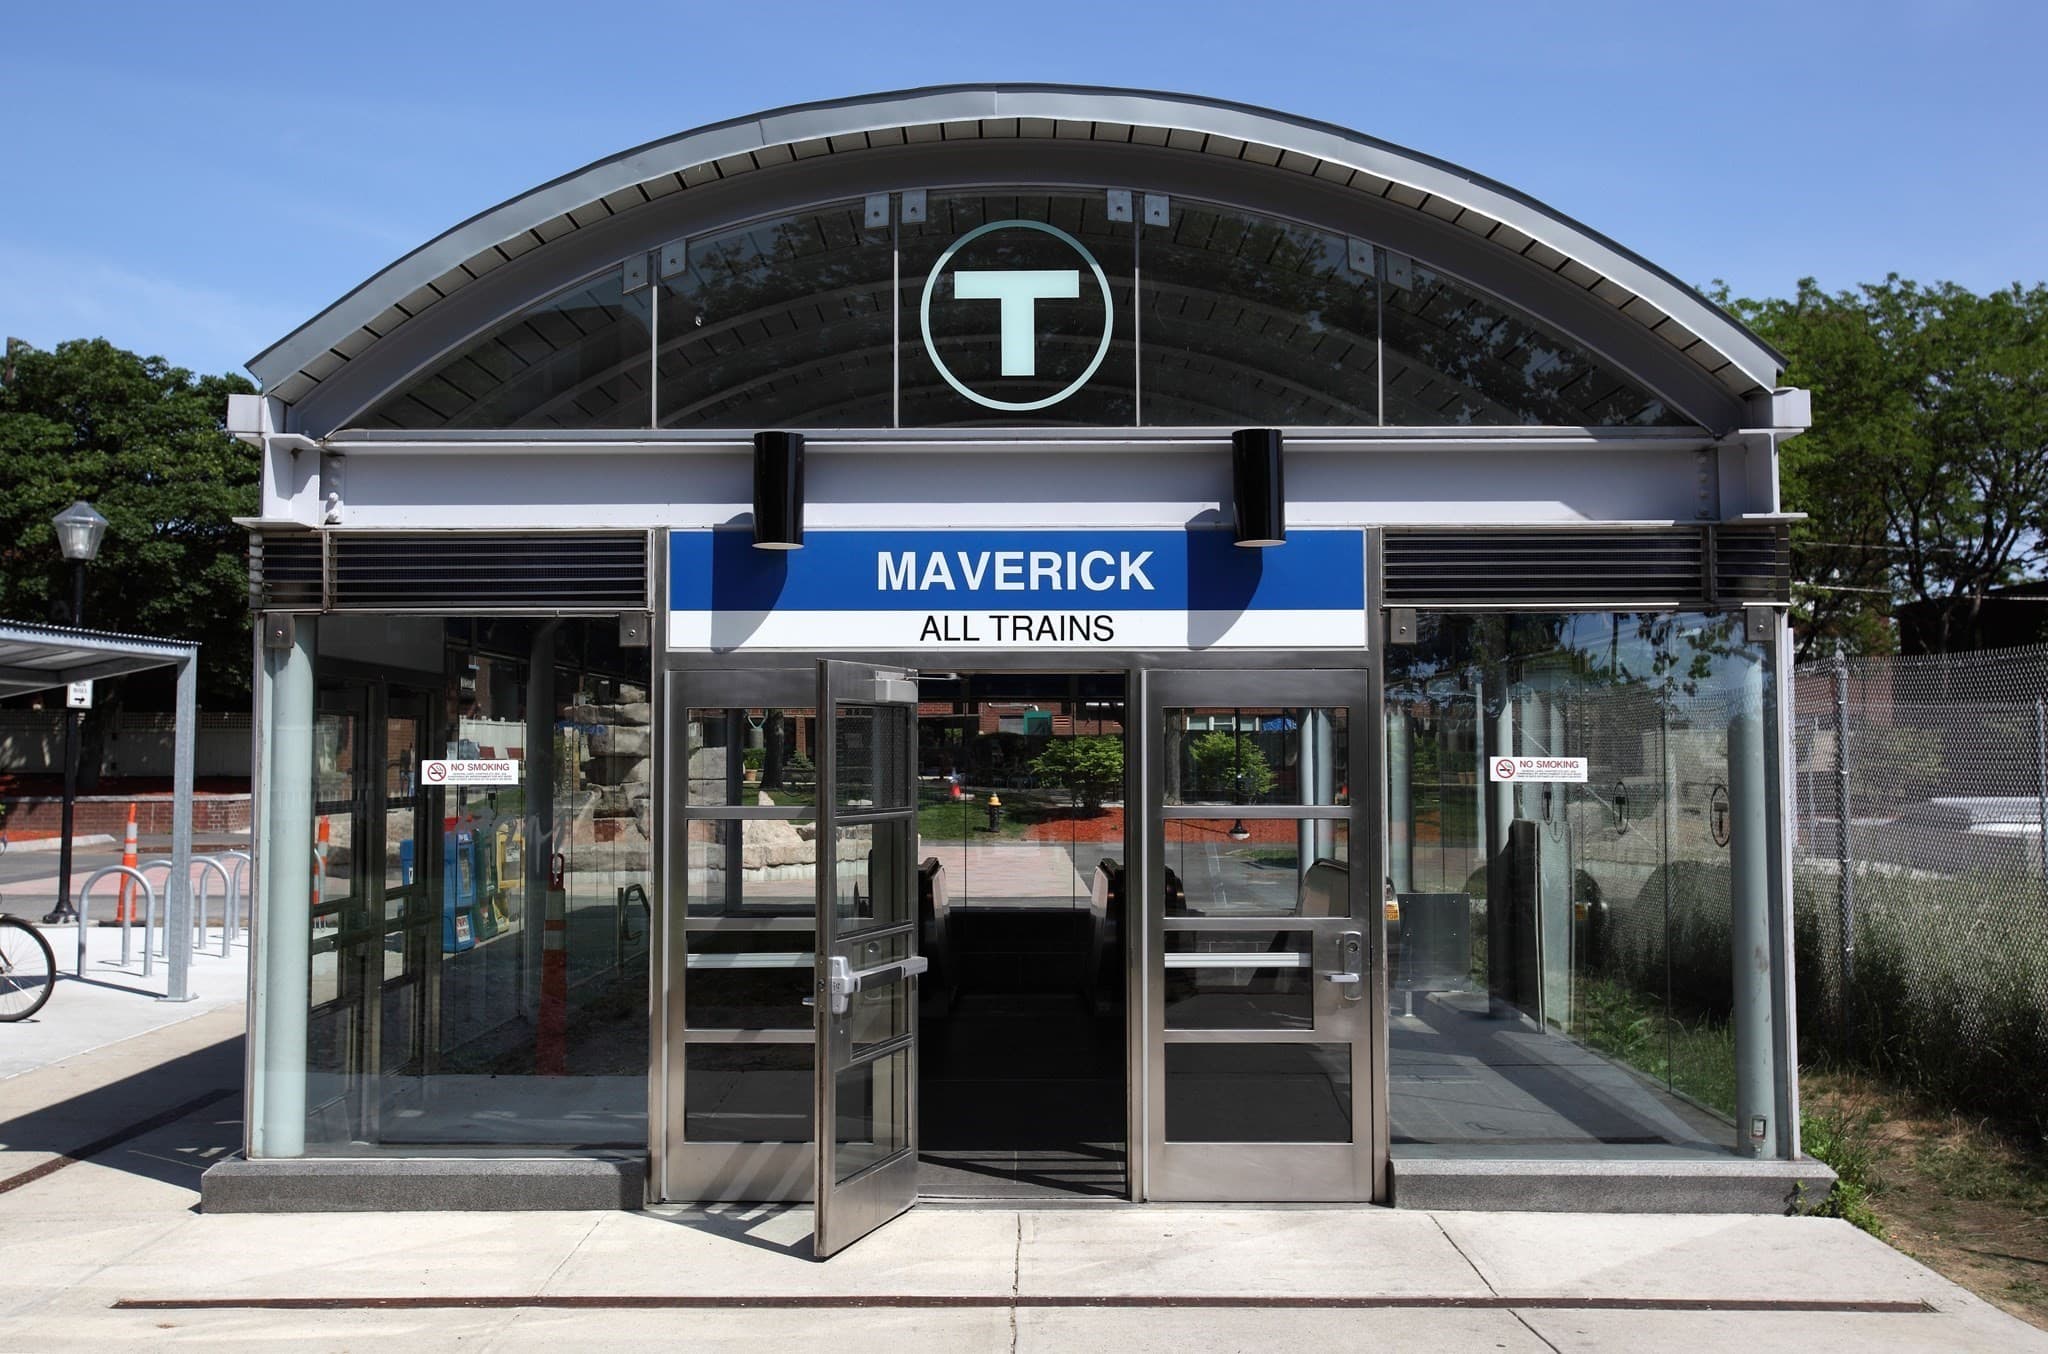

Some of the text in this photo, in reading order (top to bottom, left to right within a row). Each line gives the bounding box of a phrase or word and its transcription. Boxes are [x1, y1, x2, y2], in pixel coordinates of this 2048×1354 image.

[954, 270, 1080, 376] T
[877, 550, 1155, 591] MAVERICK
[920, 614, 1115, 642] ALL TRAINS
[450, 763, 510, 771] NO SMOKING
[1519, 760, 1579, 769] NO SMOKING
